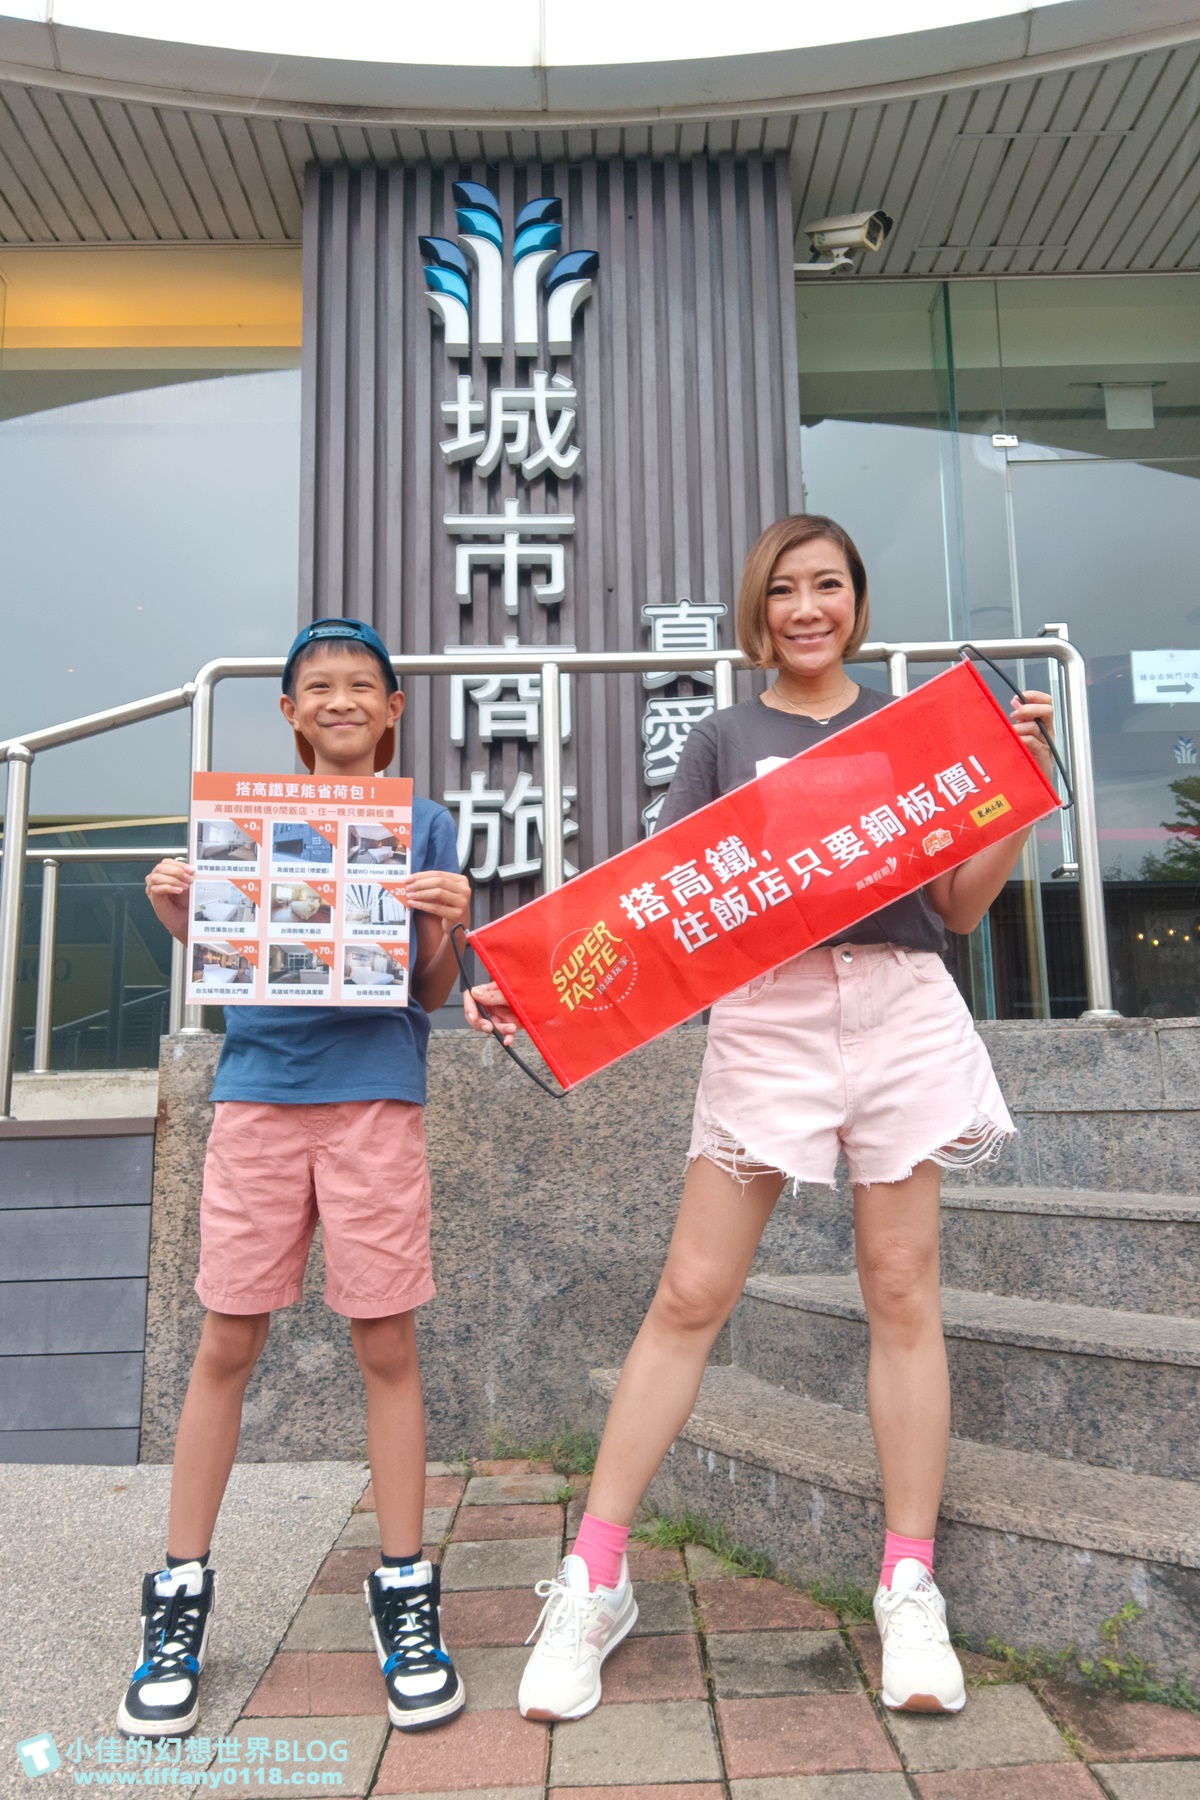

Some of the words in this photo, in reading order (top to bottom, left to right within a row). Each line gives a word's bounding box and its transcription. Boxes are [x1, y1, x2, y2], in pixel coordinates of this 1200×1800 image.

[440, 370, 581, 882] 城市商旅
[641, 598, 727, 837] 真愛
[235, 781, 376, 800] 搭高鐵更能省荷包！
[552, 920, 624, 993] SUPER
[559, 942, 618, 1012] TASTE
